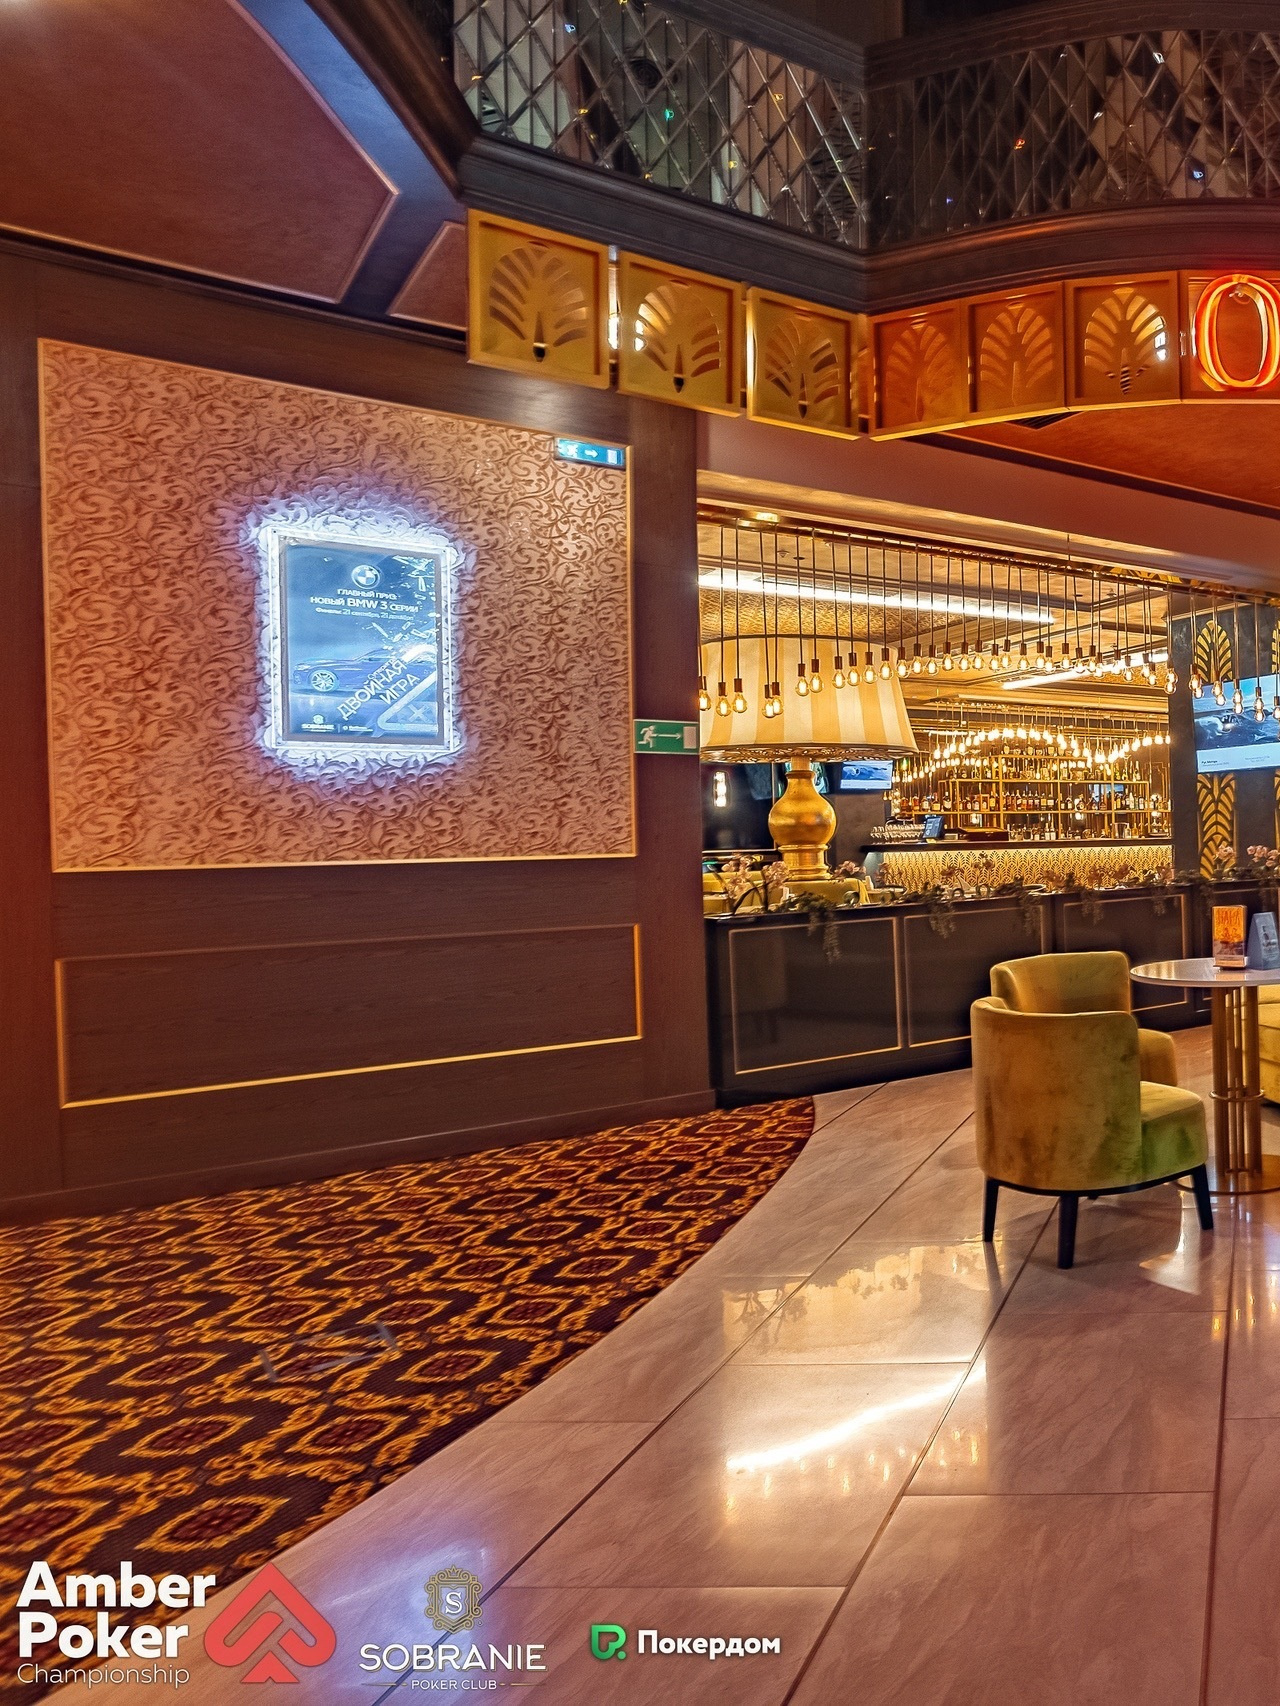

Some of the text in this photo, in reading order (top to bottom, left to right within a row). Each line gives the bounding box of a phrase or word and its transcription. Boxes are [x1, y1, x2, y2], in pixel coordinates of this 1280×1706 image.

[310, 596, 419, 612] НОВЫЙ BMW 3 СЕРИИ
[337, 588, 375, 598] ГЛАВНЫЙ
[337, 659, 407, 721] ДВОЙНАЯ
[379, 673, 420, 705] ИГРА
